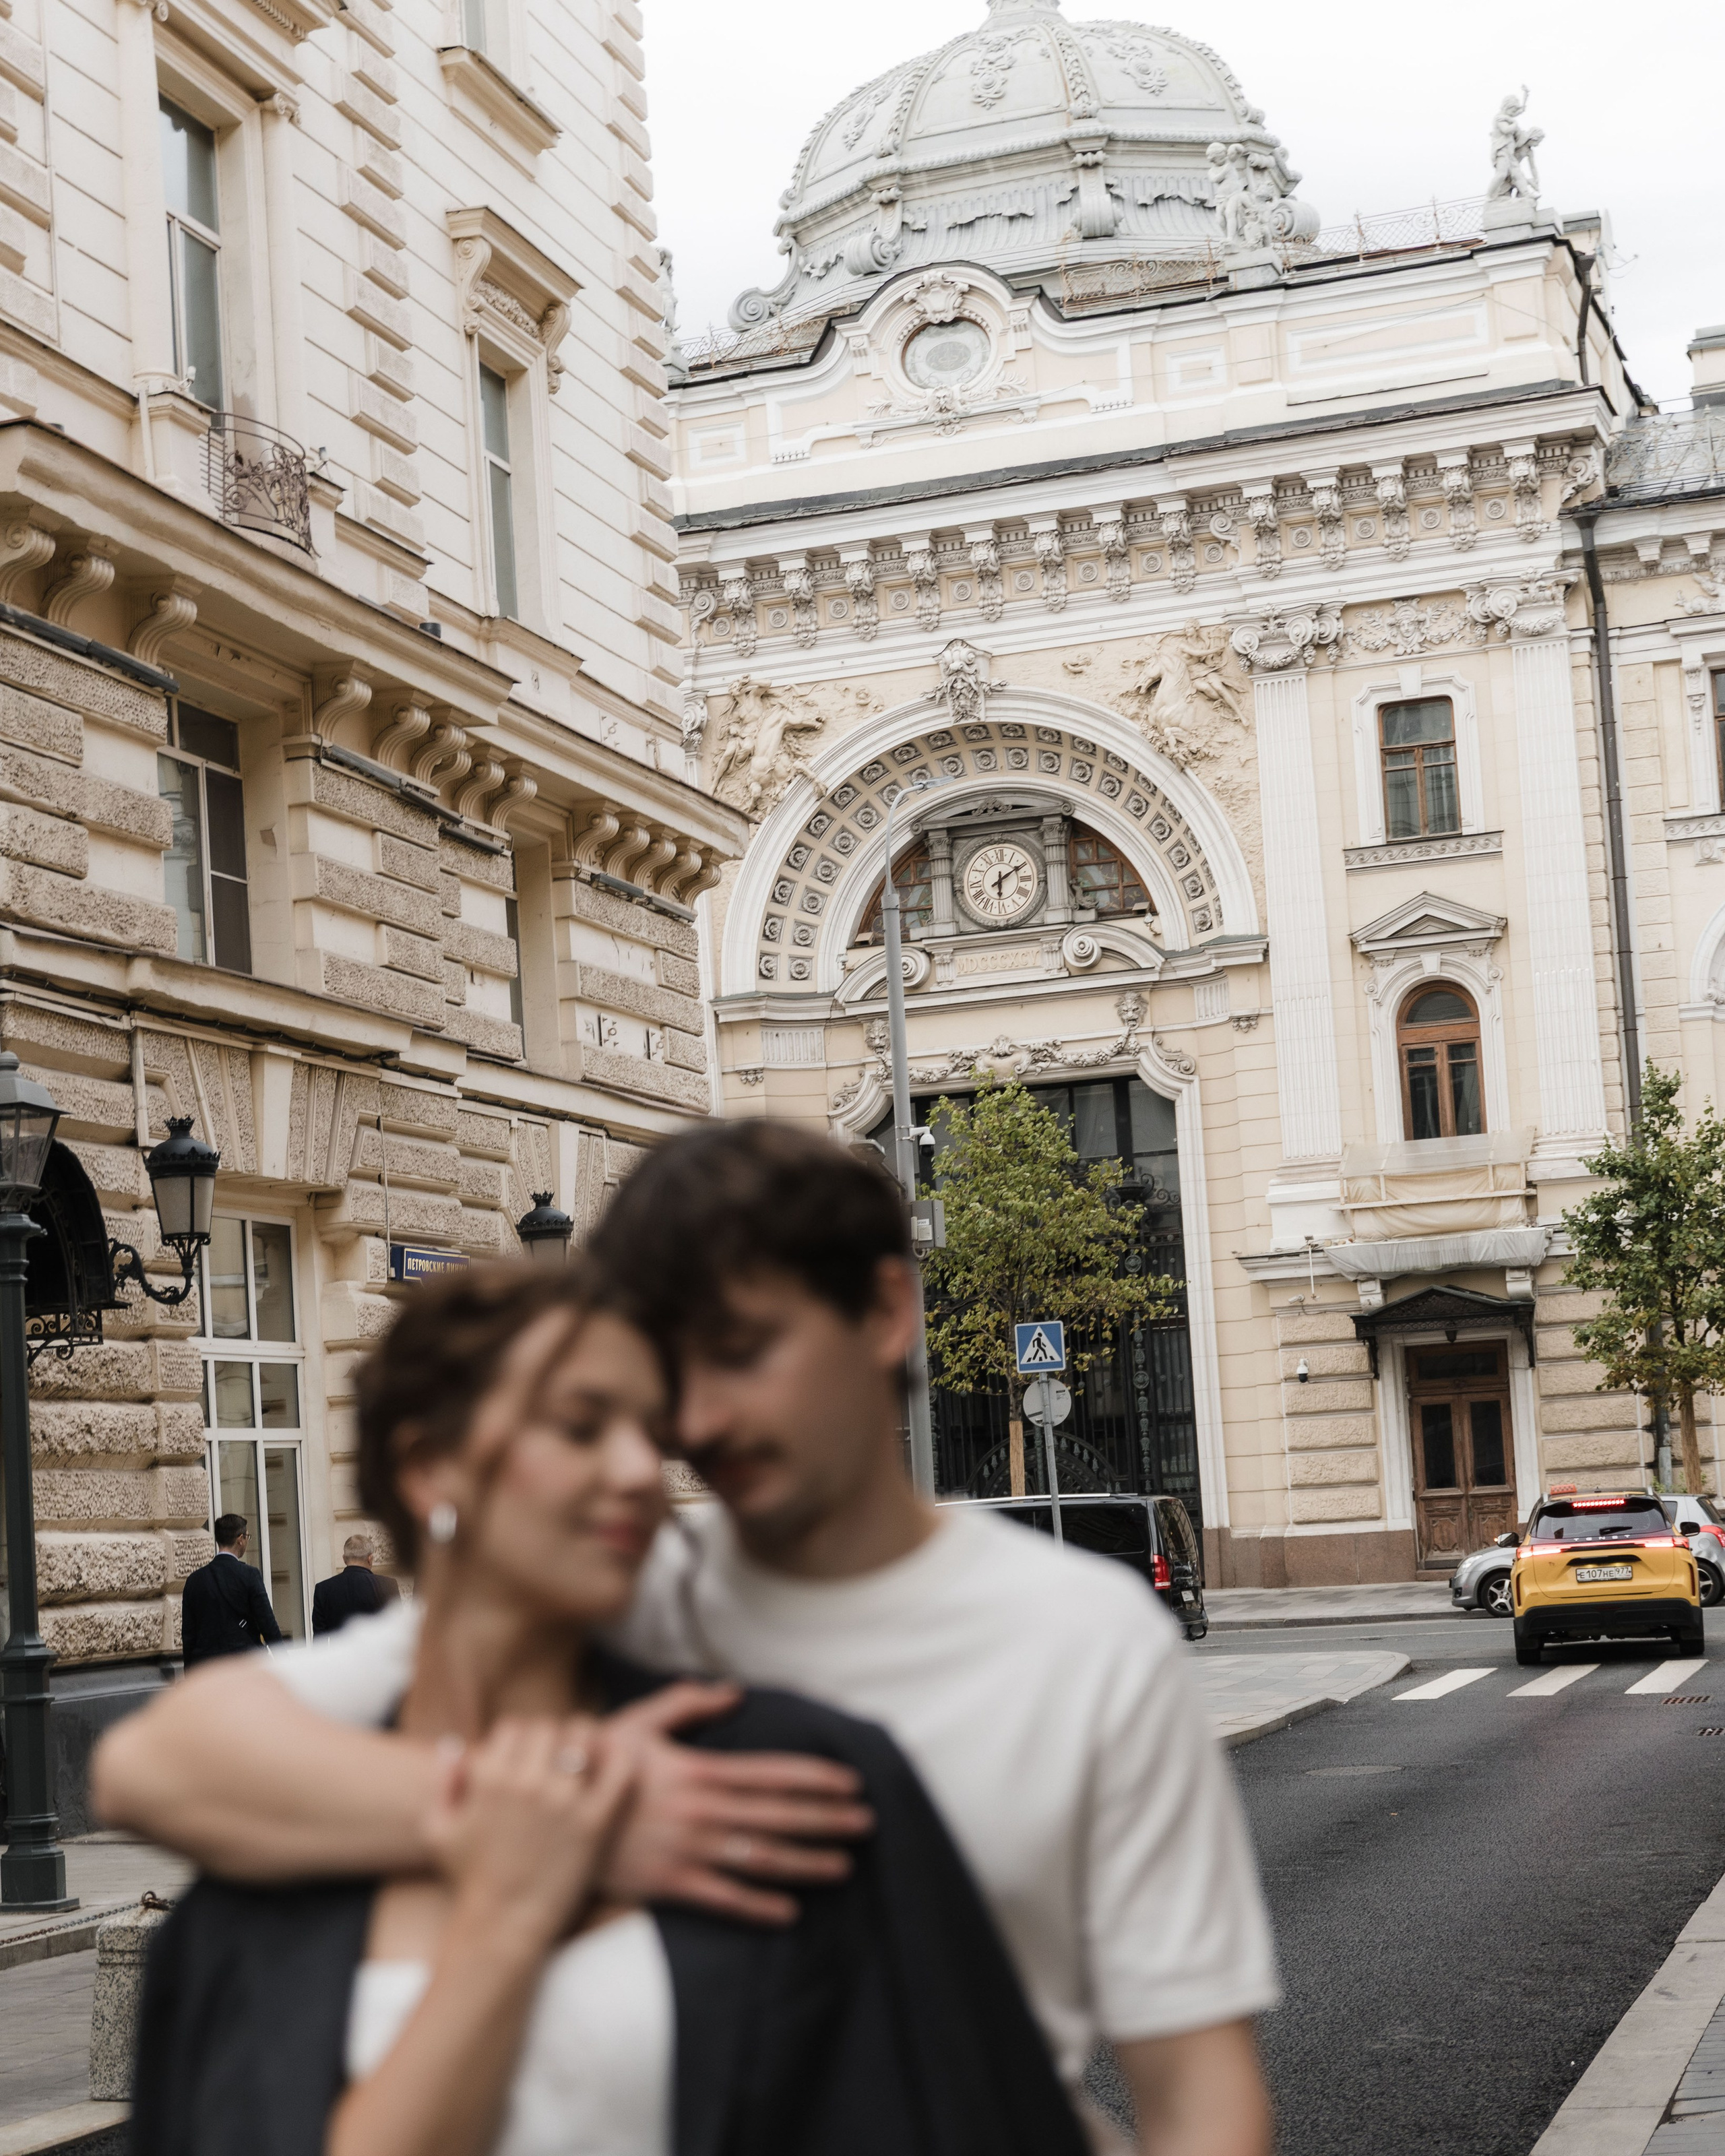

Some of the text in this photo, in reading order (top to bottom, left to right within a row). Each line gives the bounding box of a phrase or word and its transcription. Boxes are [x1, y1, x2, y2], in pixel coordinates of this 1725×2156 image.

[980, 853, 993, 868] XI
[994, 849, 1004, 862] XII
[1008, 852, 1015, 864] I
[972, 866, 984, 876] X
[969, 880, 982, 889] IX
[972, 889, 986, 906] VIII
[1011, 898, 1020, 910] V
[982, 897, 994, 912] VII
[998, 901, 1007, 914] VI
[957, 951, 1040, 974] MDCCCXCV
[407, 1257, 468, 1274] ПЕТРОВСКИЕ ЛИНИИ
[1573, 1534, 1631, 1542] TENET
